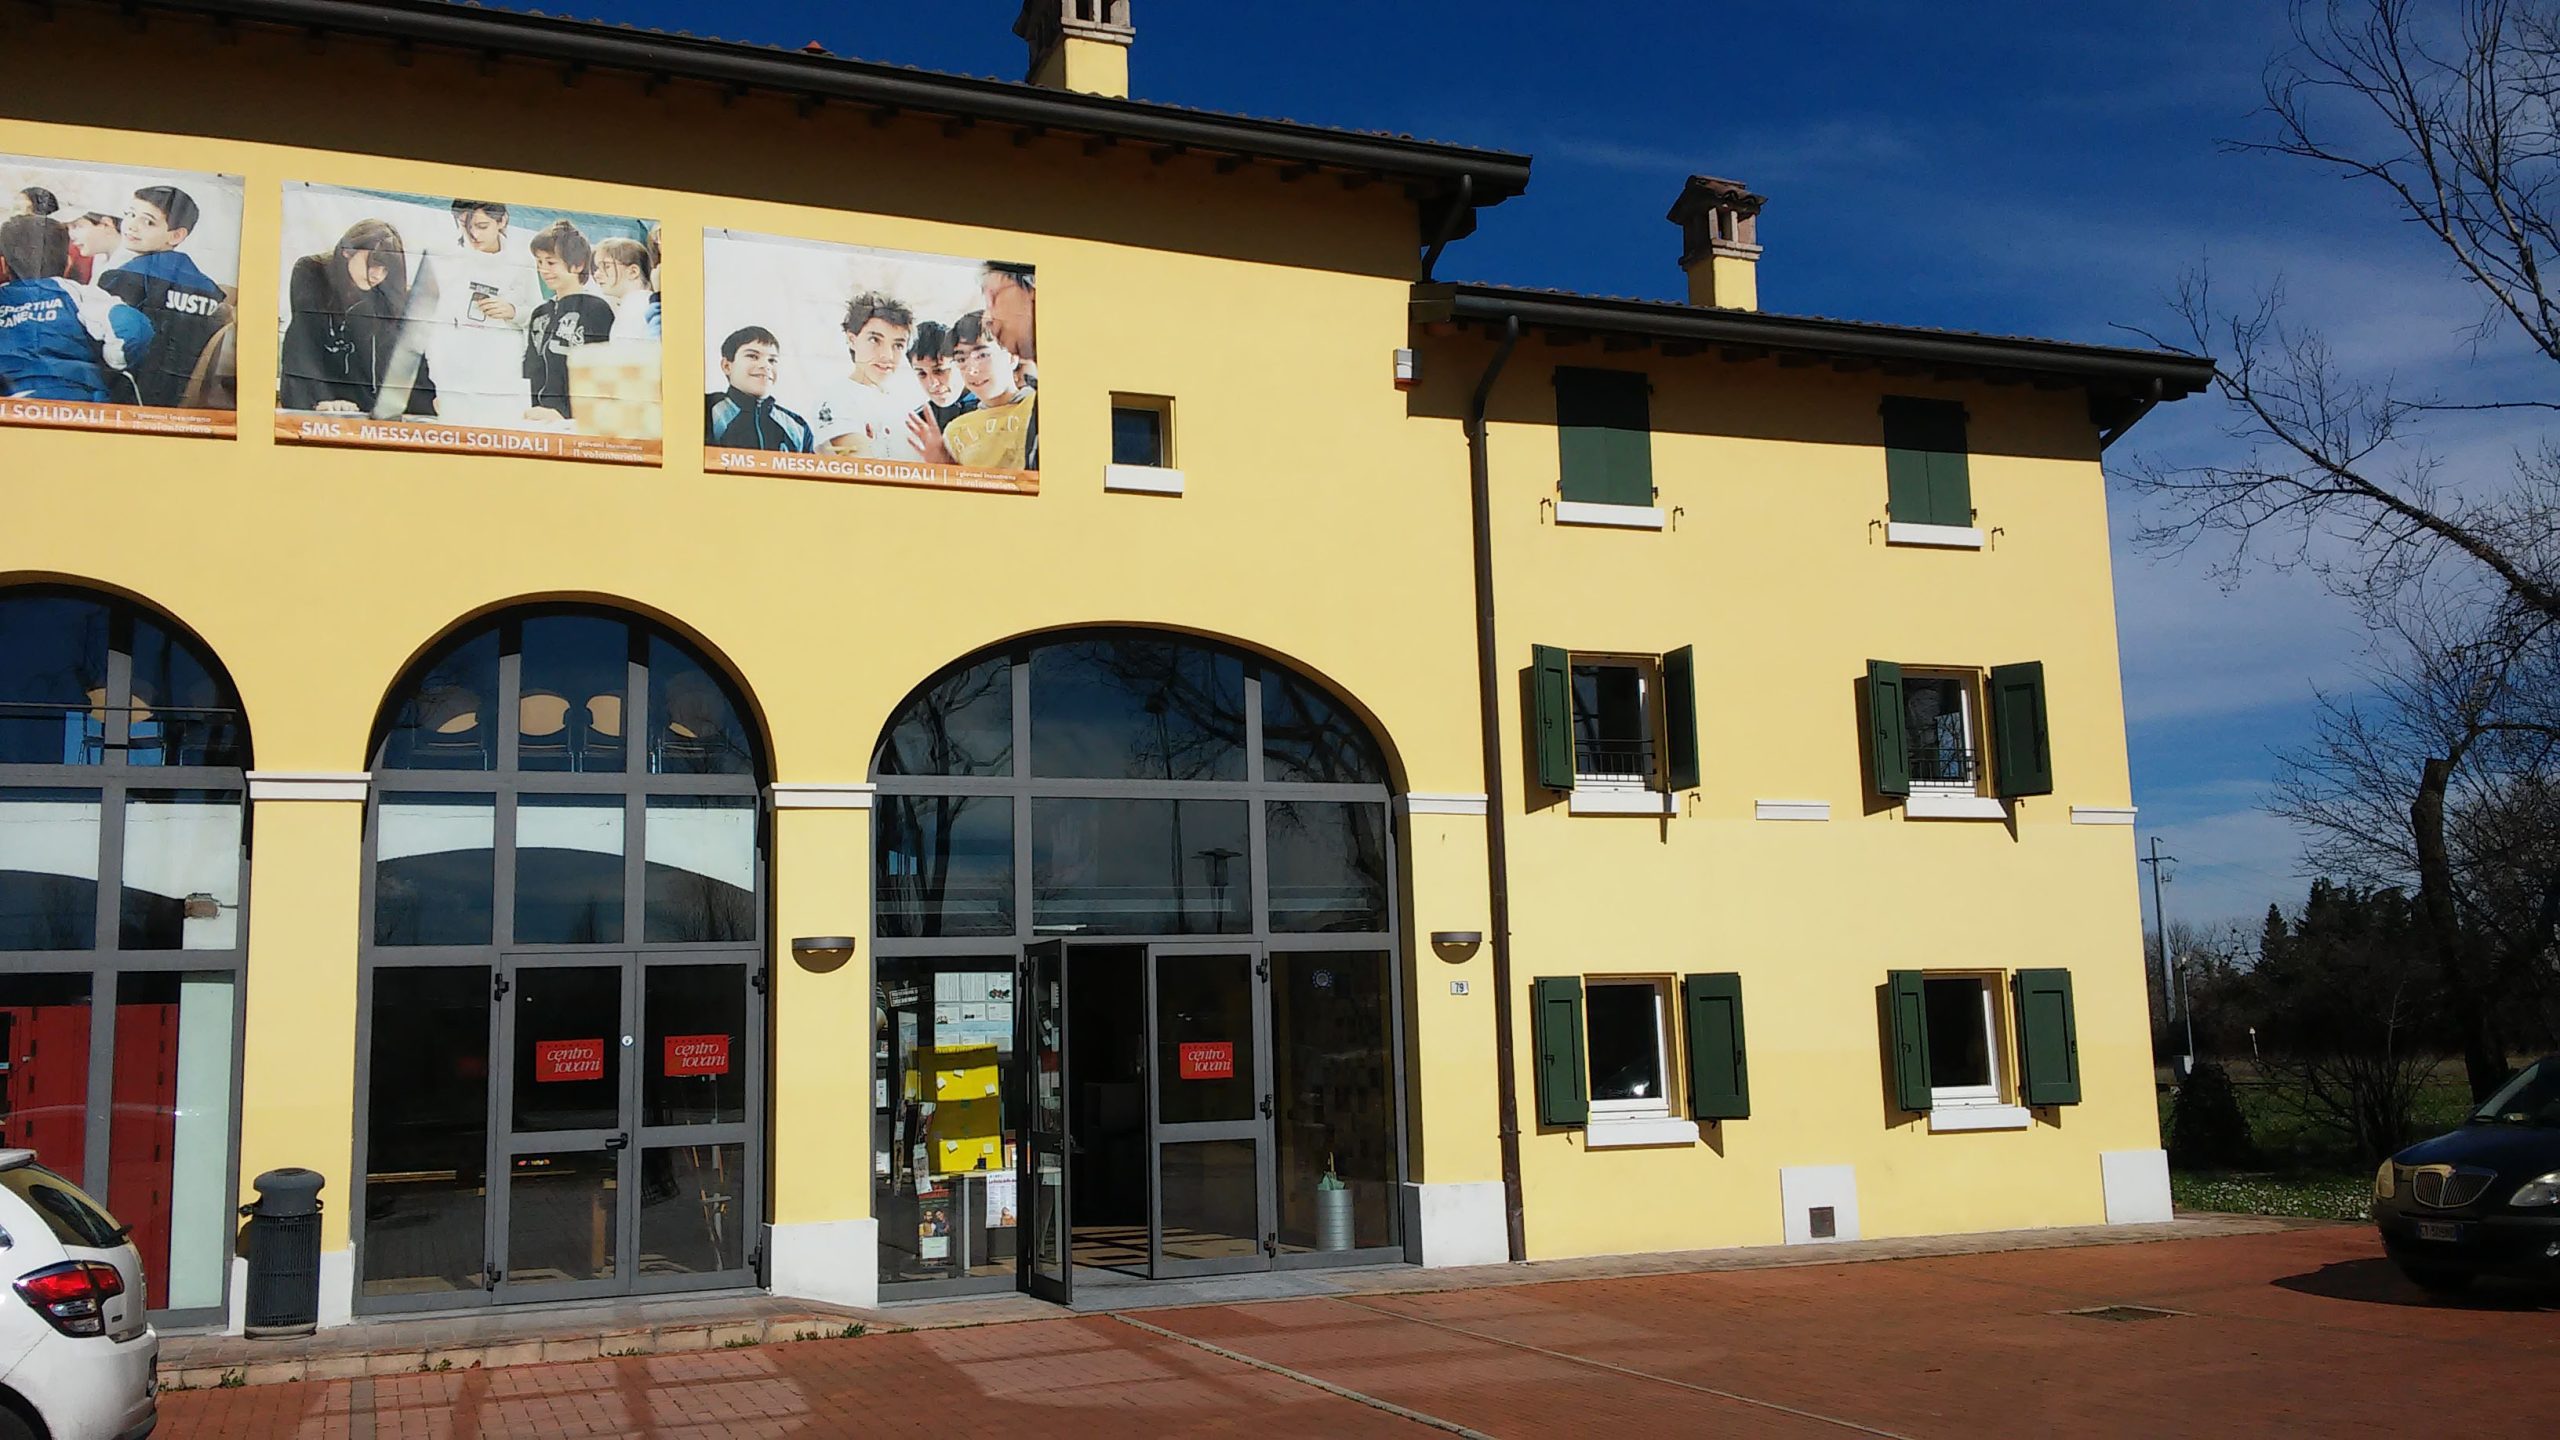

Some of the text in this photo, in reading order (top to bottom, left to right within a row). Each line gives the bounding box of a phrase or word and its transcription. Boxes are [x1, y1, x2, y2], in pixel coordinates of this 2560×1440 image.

[166, 289, 208, 315] JUST
[12, 404, 105, 424] SOLIDALI
[300, 421, 341, 437] SMS
[359, 425, 461, 446] MESSAGGI
[466, 432, 549, 452] SOLIDALI
[720, 453, 755, 468] SMS
[771, 456, 858, 476] MESSAGGI
[864, 464, 935, 481] SOLIDALI
[547, 1047, 593, 1061] centro
[675, 1042, 719, 1056] centro
[1188, 1048, 1225, 1061] centro
